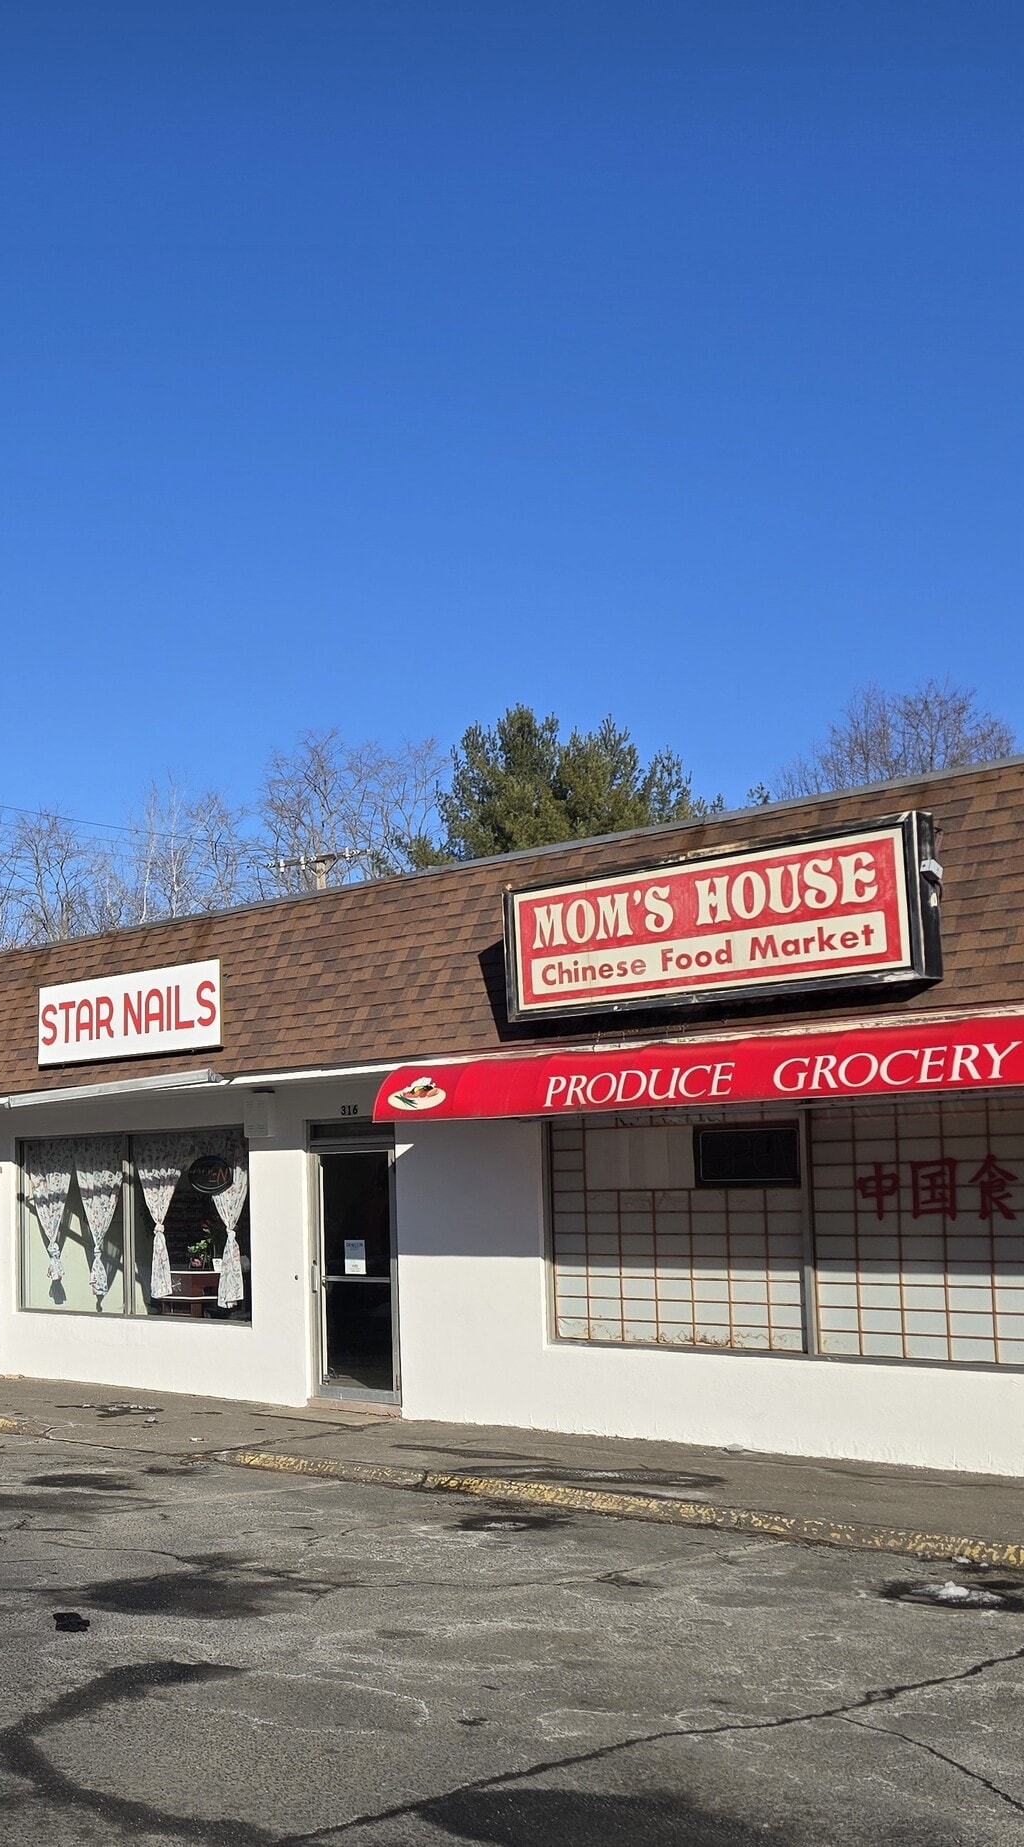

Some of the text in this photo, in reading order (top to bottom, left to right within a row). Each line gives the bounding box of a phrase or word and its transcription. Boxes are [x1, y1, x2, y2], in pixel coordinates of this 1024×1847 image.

[532, 851, 879, 950] MOM'S HOUSE
[541, 923, 875, 987] Chinese Food Market
[41, 980, 217, 1046] STAR NAILS
[543, 1041, 1024, 1108] PRODUCE GROCERY
[341, 1104, 358, 1116] 316
